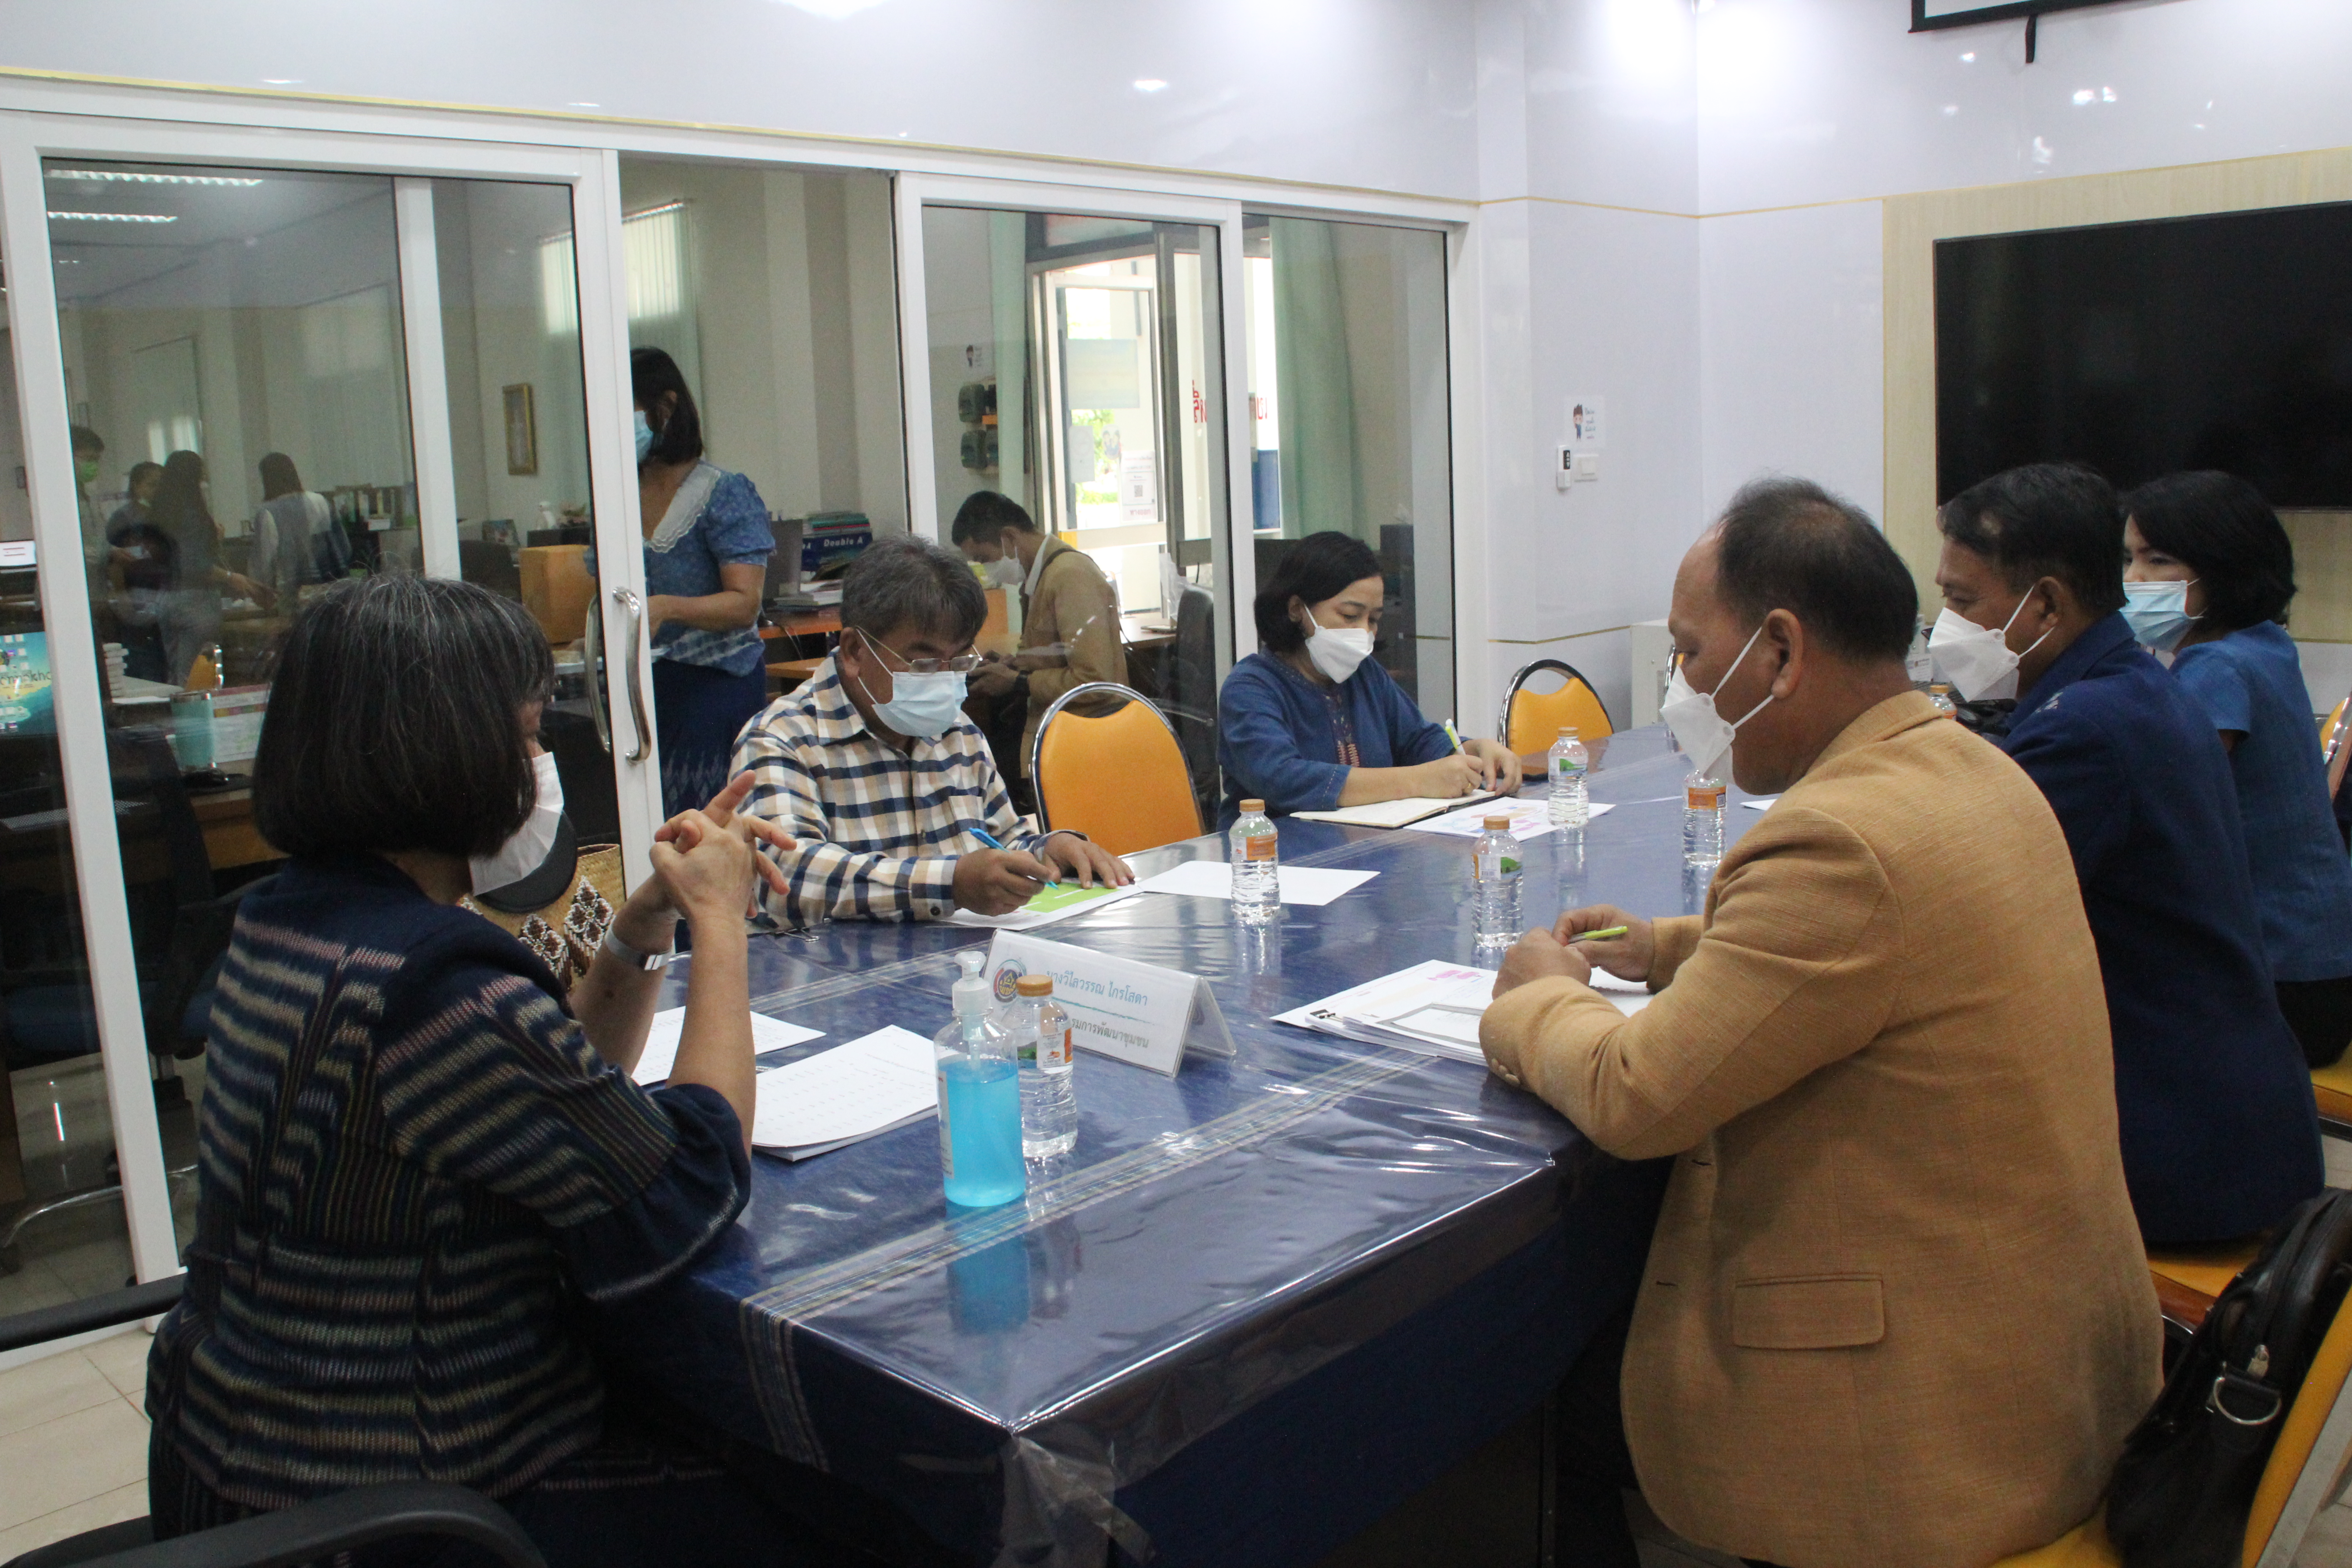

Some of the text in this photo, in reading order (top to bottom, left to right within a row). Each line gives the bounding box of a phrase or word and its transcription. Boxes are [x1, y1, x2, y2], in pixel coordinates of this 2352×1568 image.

[824, 537, 854, 547] Double
[1108, 980, 1147, 1006] ไกรโสดา
[1072, 1018, 1149, 1048] รมการพัฒนาชุมชน
